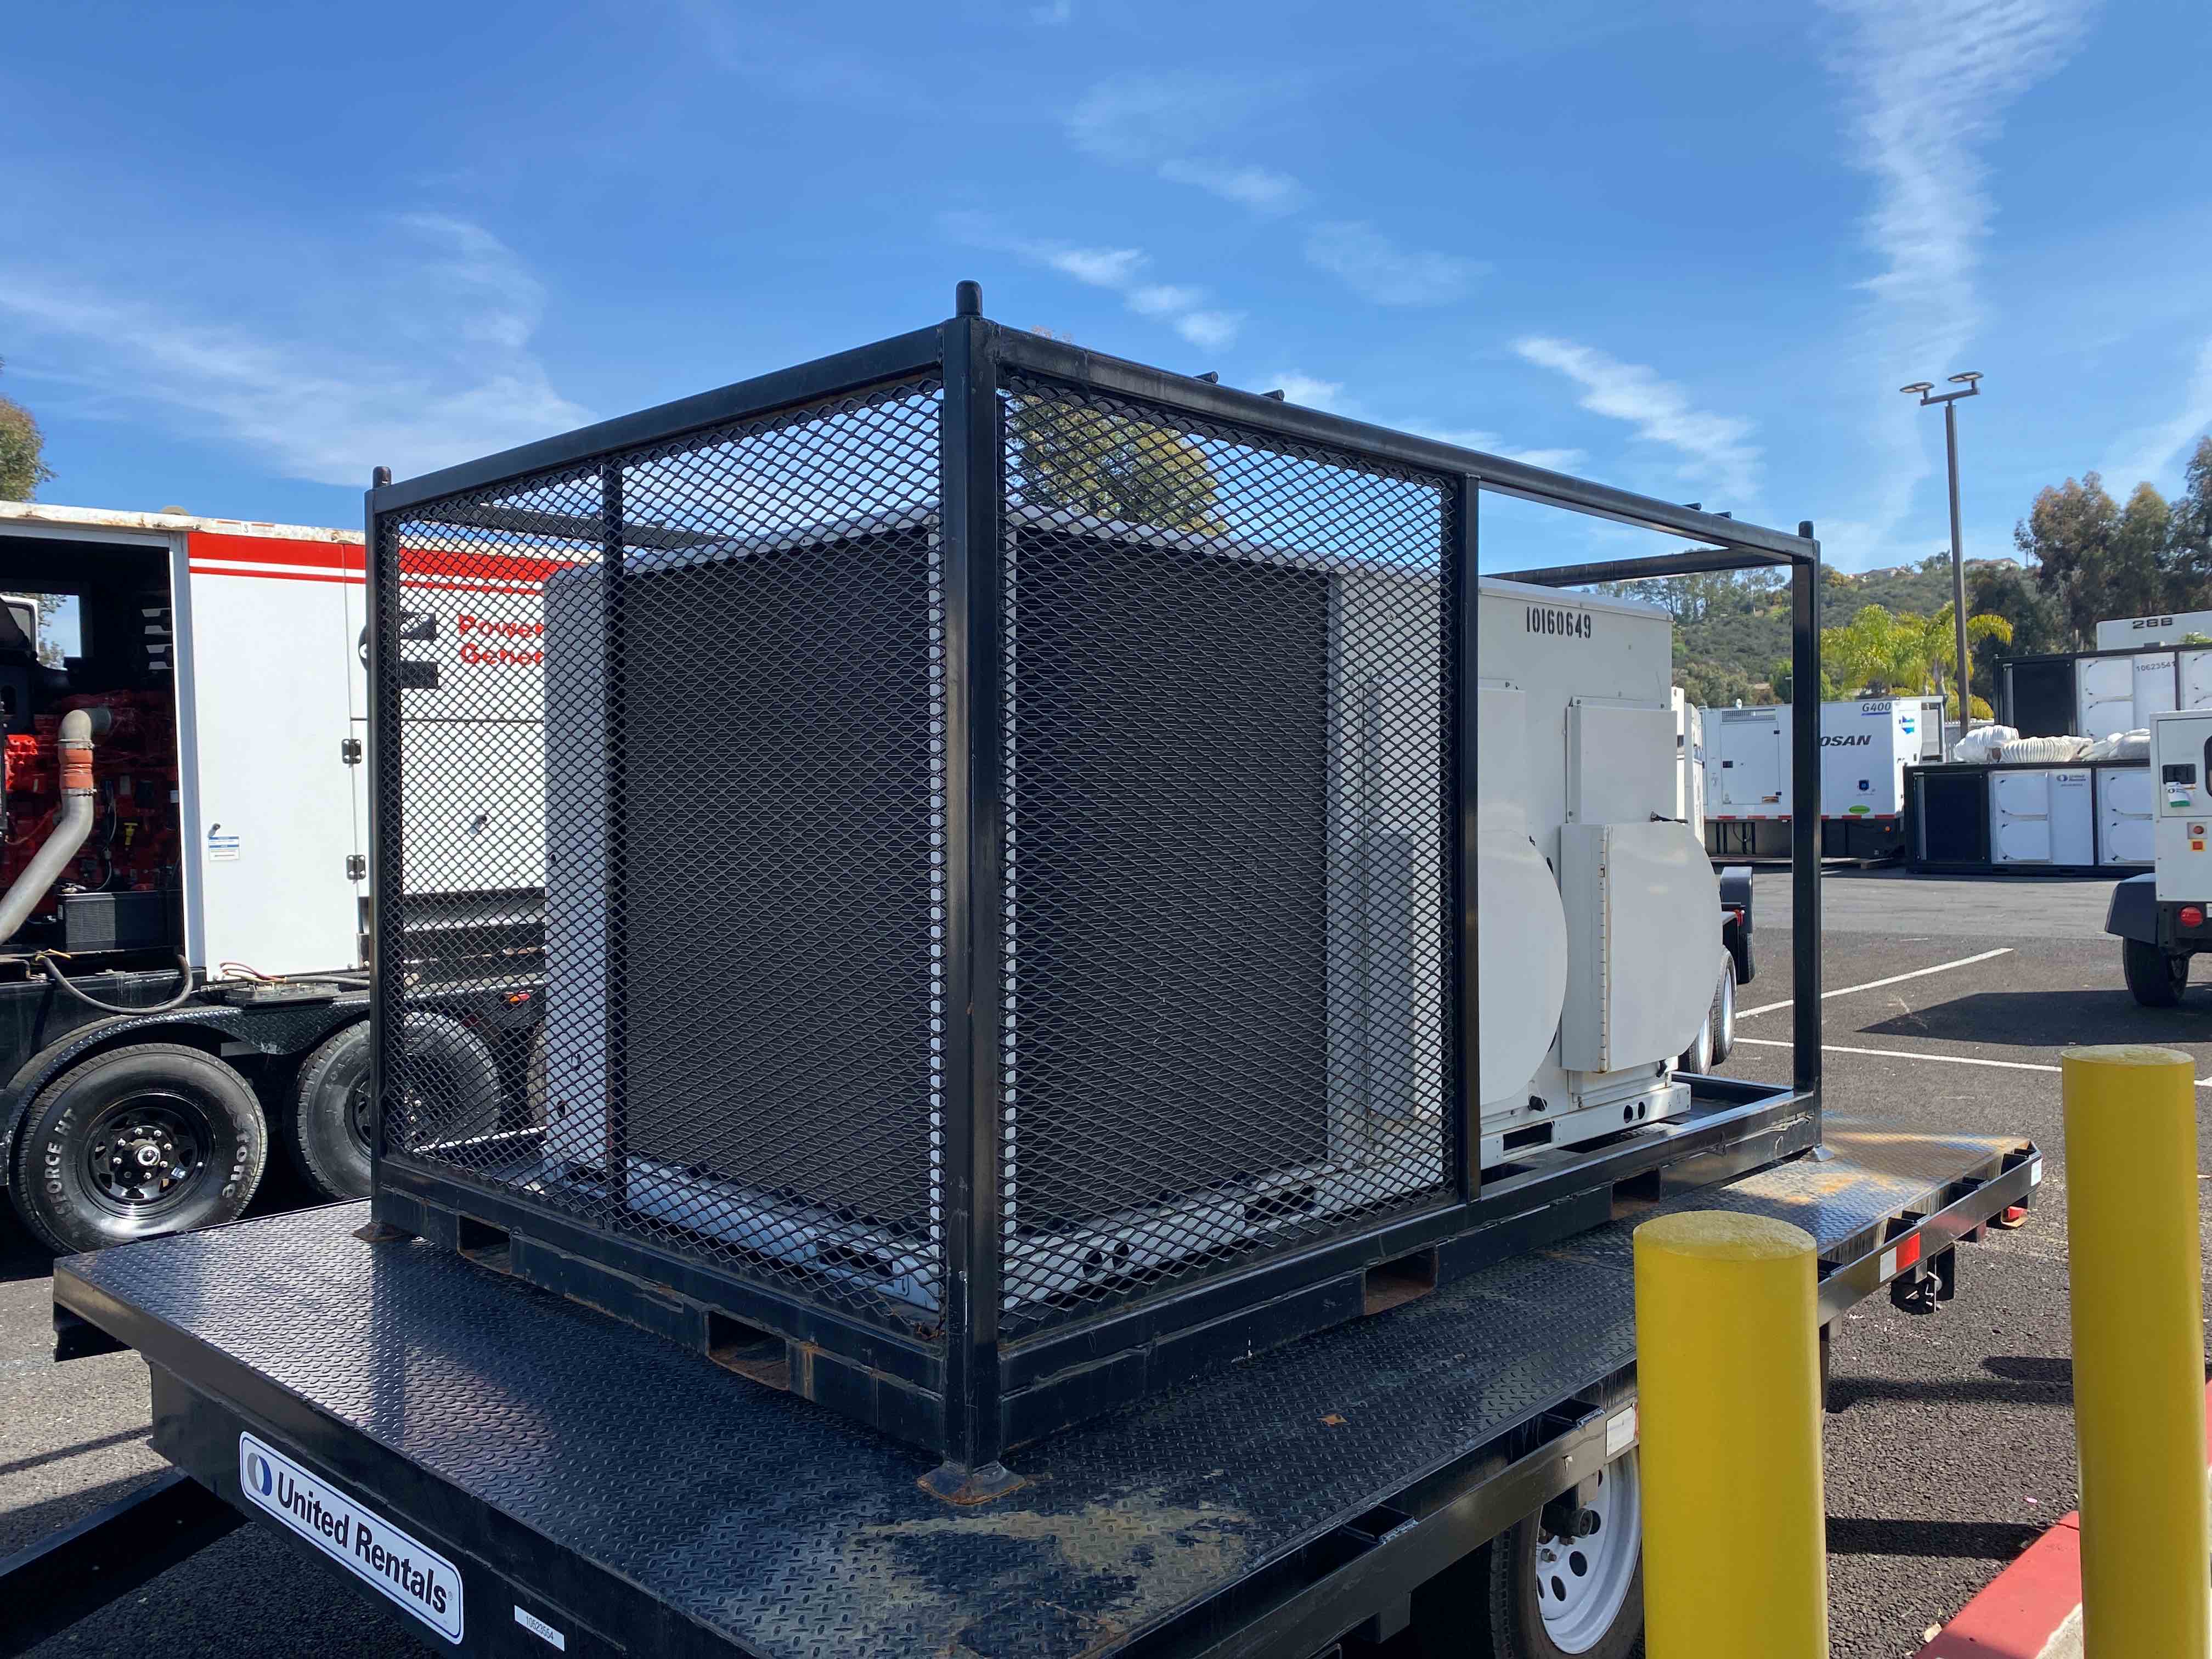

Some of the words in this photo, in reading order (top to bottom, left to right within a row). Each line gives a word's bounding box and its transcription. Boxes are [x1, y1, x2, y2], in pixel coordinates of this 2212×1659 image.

[1527, 606, 1591, 639] 10160649
[460, 642, 544, 664] Gener
[1862, 702, 1892, 712] G400
[1820, 734, 1872, 747] OSAN
[278, 1471, 350, 1549] United
[356, 1521, 447, 1614] Rentals
